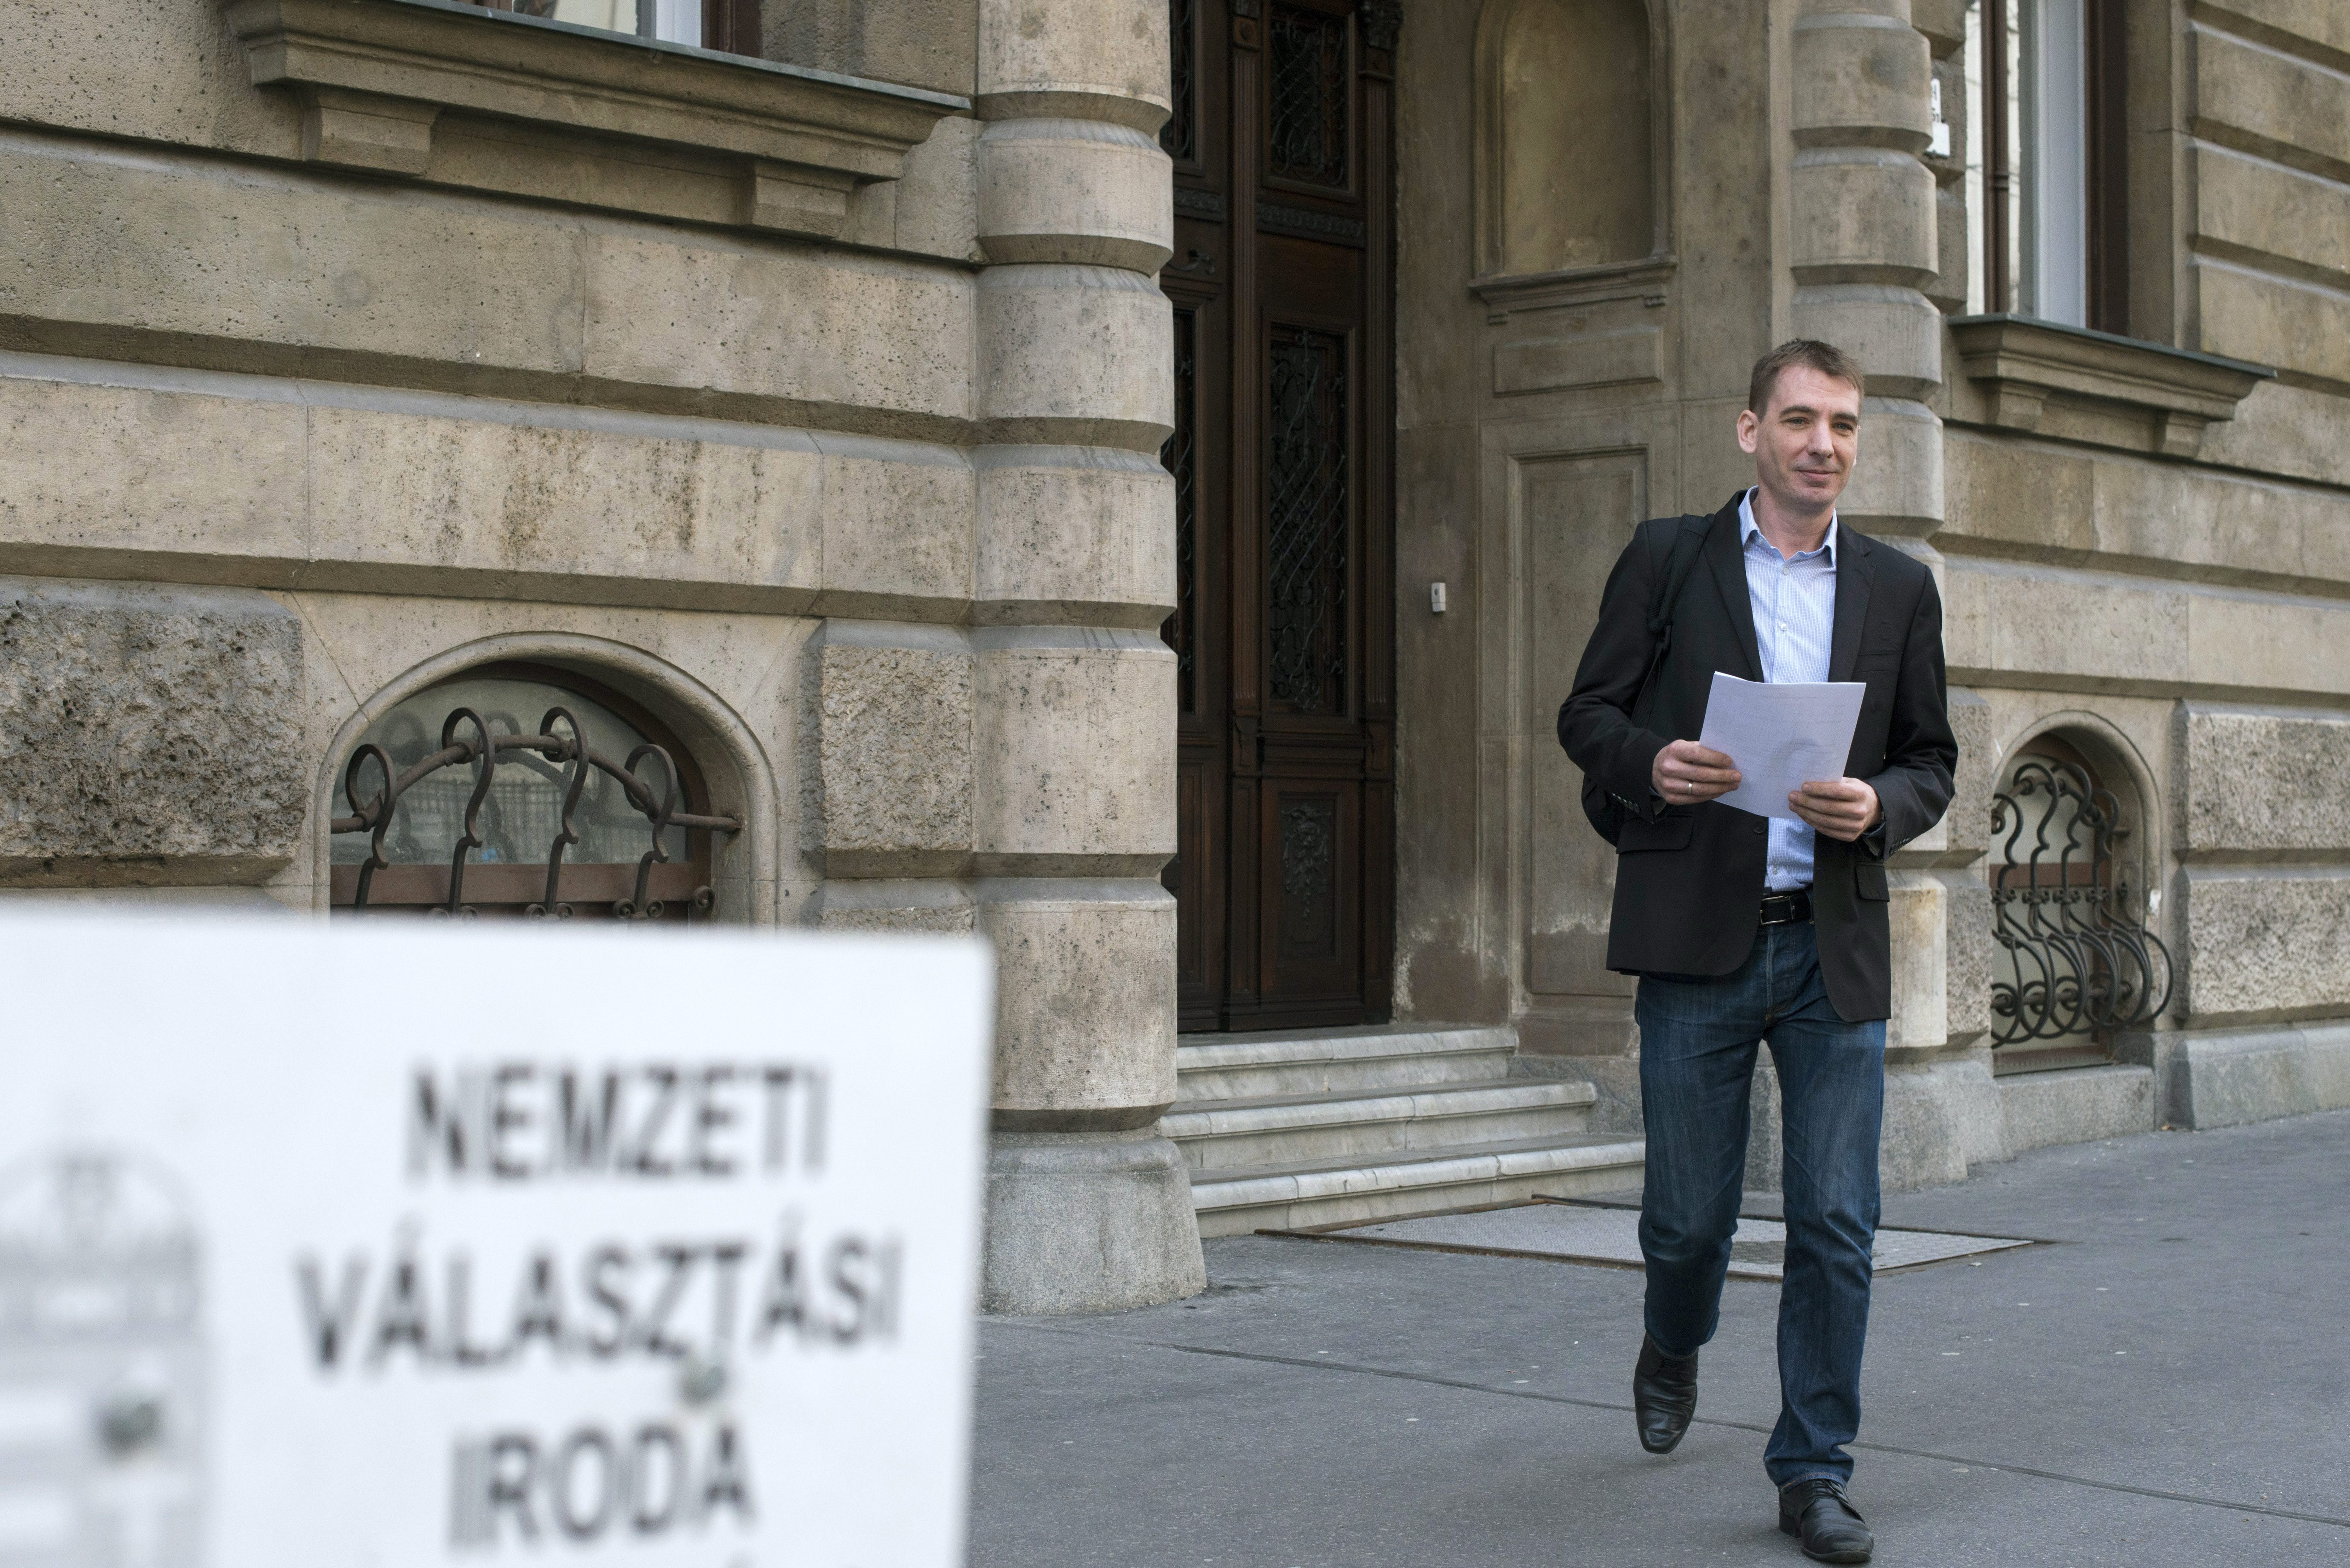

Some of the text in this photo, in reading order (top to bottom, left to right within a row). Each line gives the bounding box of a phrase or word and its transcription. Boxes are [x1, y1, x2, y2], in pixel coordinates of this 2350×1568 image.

[407, 1060, 827, 1185] NEMZETI
[292, 1211, 902, 1372] VÁLASZTÁSI
[446, 1420, 758, 1552] IRODA
